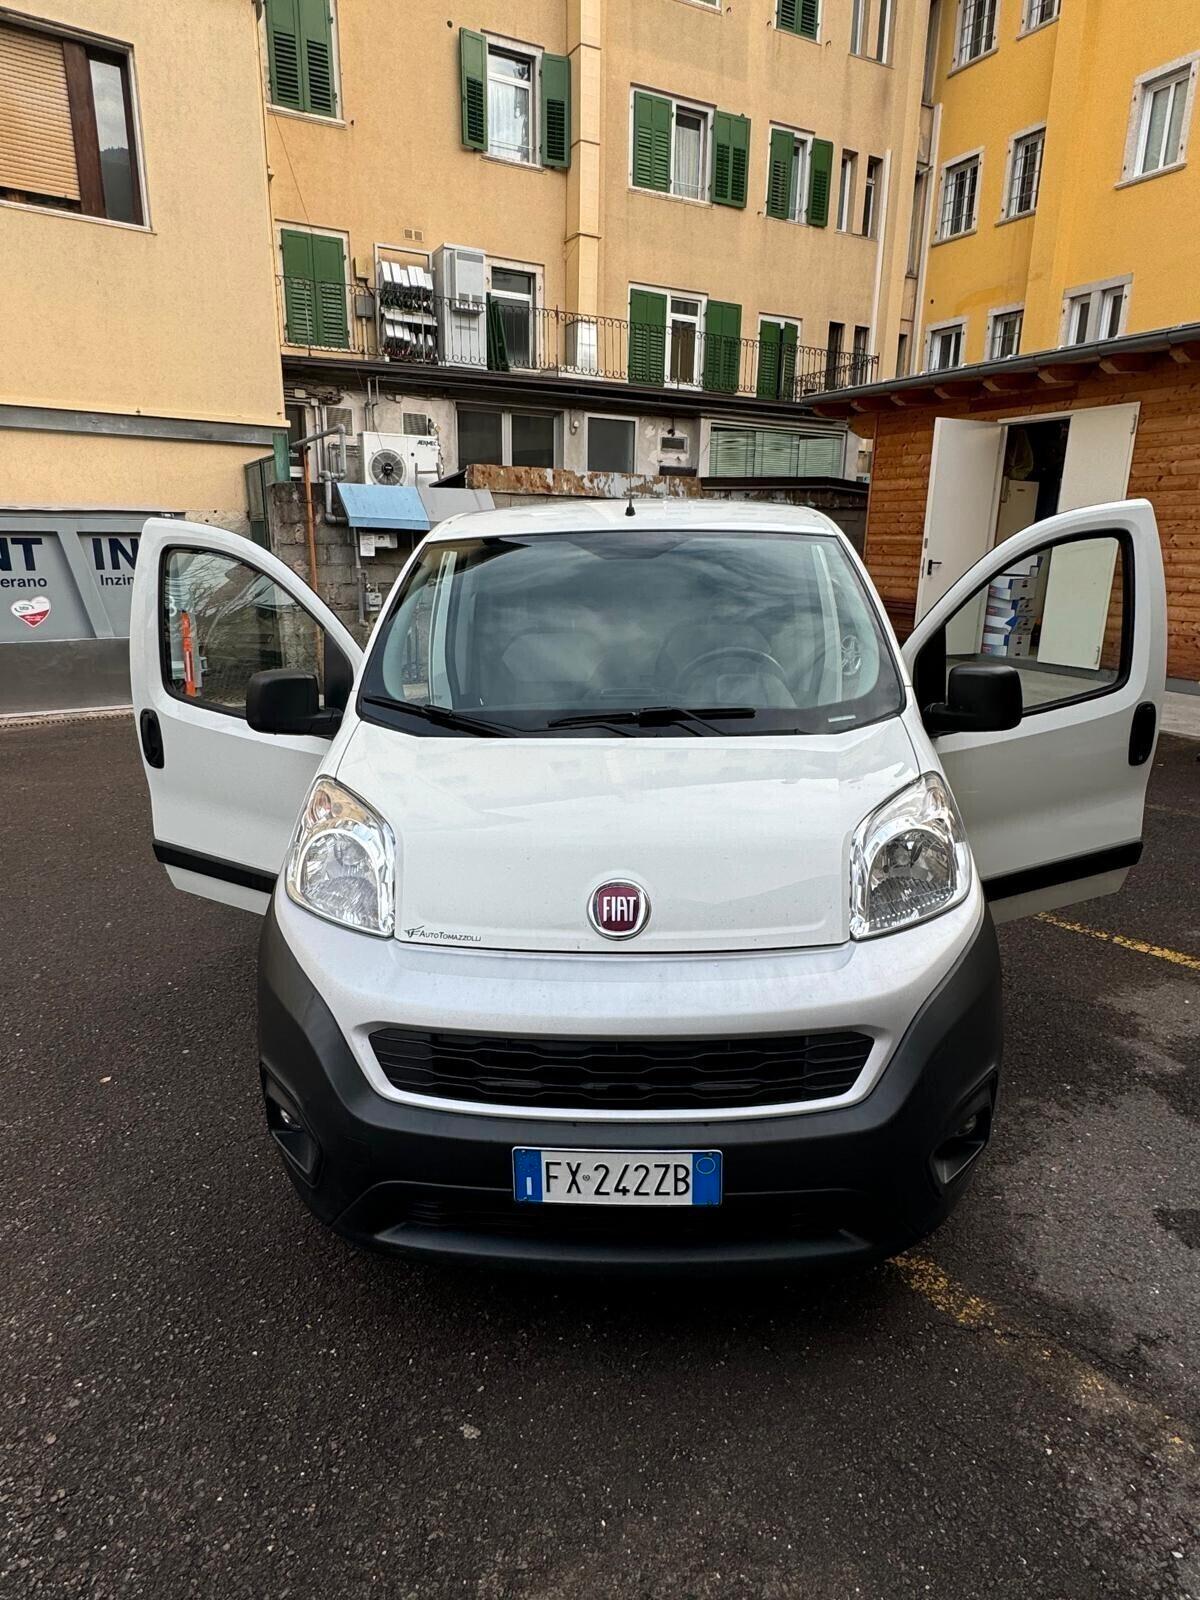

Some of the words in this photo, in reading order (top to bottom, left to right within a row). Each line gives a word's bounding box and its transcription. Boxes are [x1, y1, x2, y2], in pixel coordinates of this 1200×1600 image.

[92, 537, 140, 570] IN
[0, 577, 48, 588] erano
[603, 896, 637, 922] FIAT
